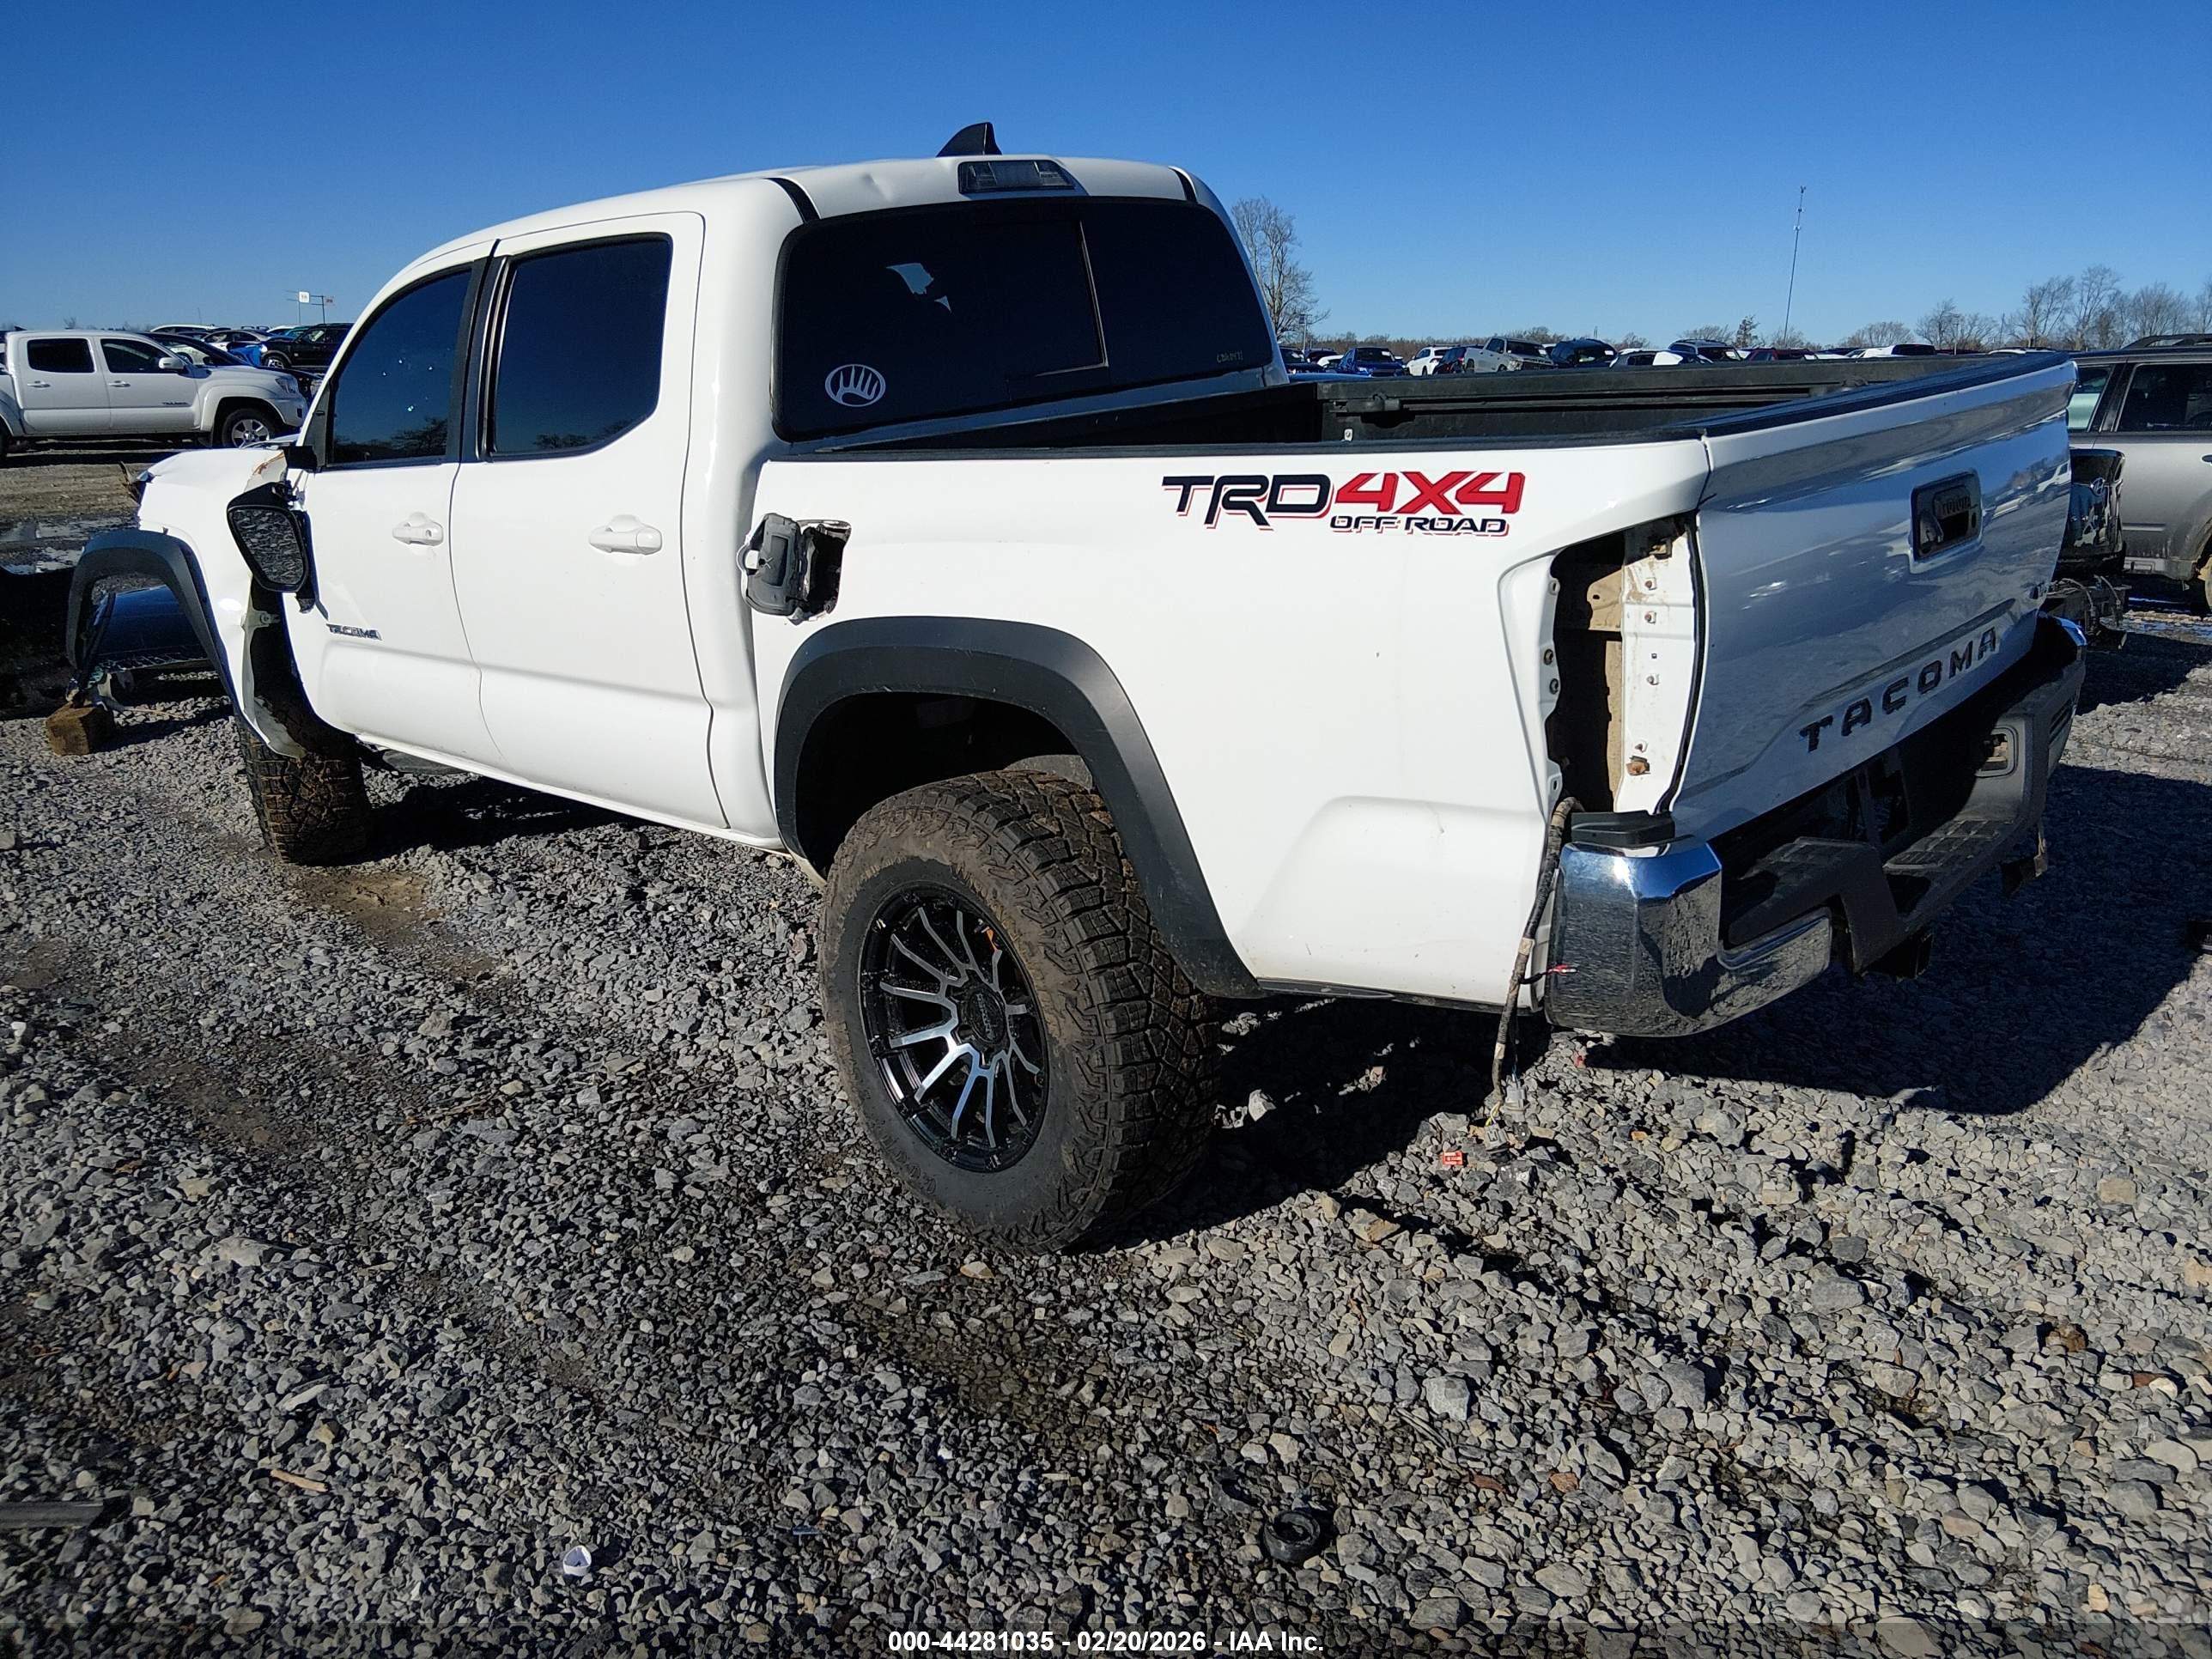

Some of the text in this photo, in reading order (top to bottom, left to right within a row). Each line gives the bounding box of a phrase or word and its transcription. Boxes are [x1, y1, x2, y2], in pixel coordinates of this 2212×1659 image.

[1162, 474, 1334, 530] TRD
[1329, 514, 1510, 537] OFF ROAD
[1799, 626, 1996, 753] TACOMA
